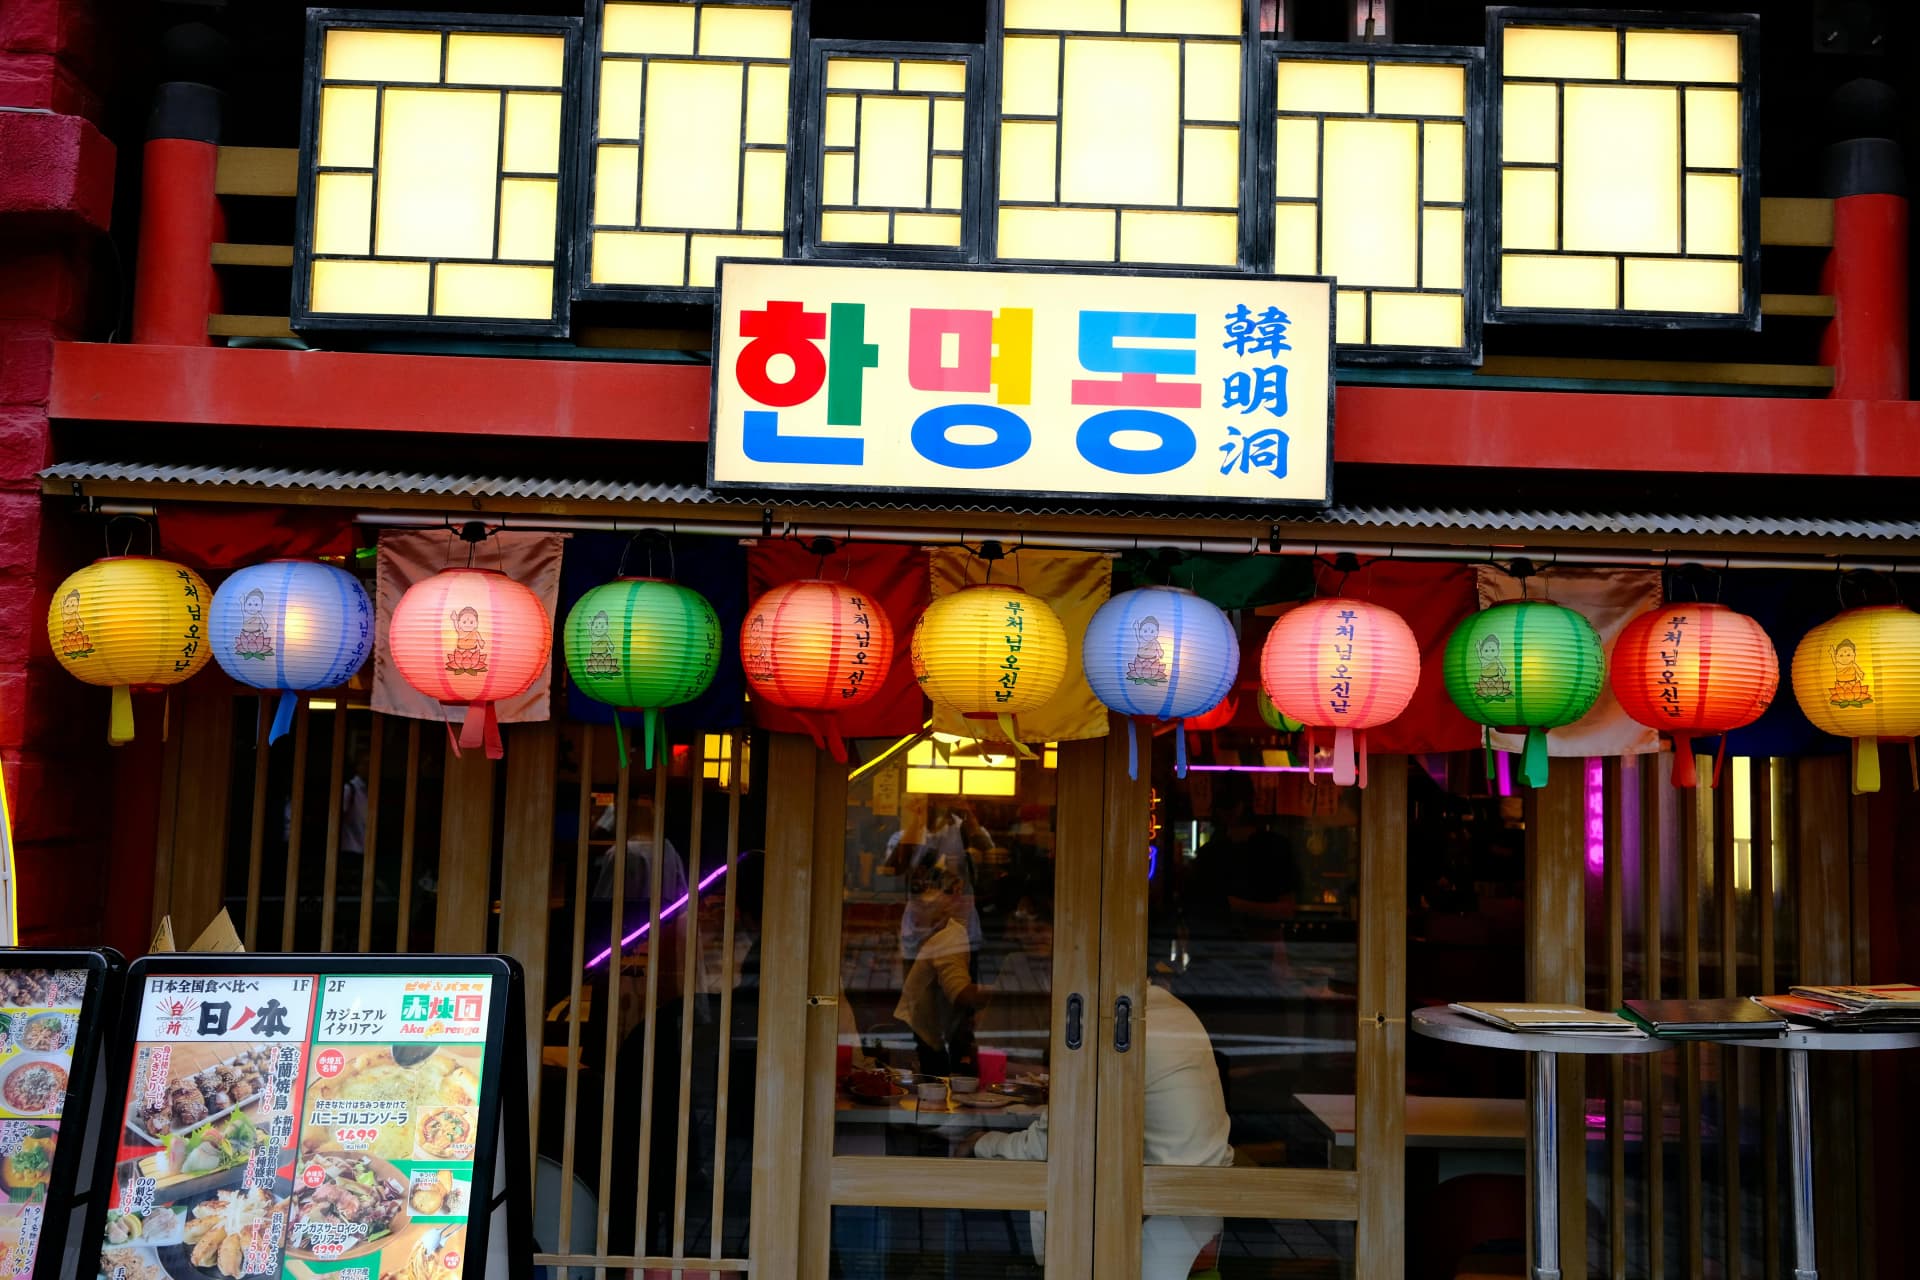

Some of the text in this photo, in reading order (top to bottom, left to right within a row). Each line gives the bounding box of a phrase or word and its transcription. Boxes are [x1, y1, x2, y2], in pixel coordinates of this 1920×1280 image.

[735, 300, 1202, 475] 한명동
[1220, 303, 1293, 480] 韓明洞
[995, 601, 1025, 702] 부처님오신날
[1330, 610, 1358, 714] 부처님오신날
[151, 979, 259, 993] 日本全国食べ比べ
[293, 979, 310, 991] 1F
[327, 980, 346, 992] 2F
[325, 1008, 387, 1021] カジュアル
[323, 1023, 384, 1036] イタリアン
[400, 1024, 425, 1034] Aka
[273, 1046, 295, 1110] 室蘭焼鳥
[311, 1112, 409, 1125] ハニーゴルゴンゾーラ
[337, 1129, 378, 1142] 1499
[294, 1224, 367, 1233] アンガスサーロインの
[312, 1235, 347, 1244] タリアータ
